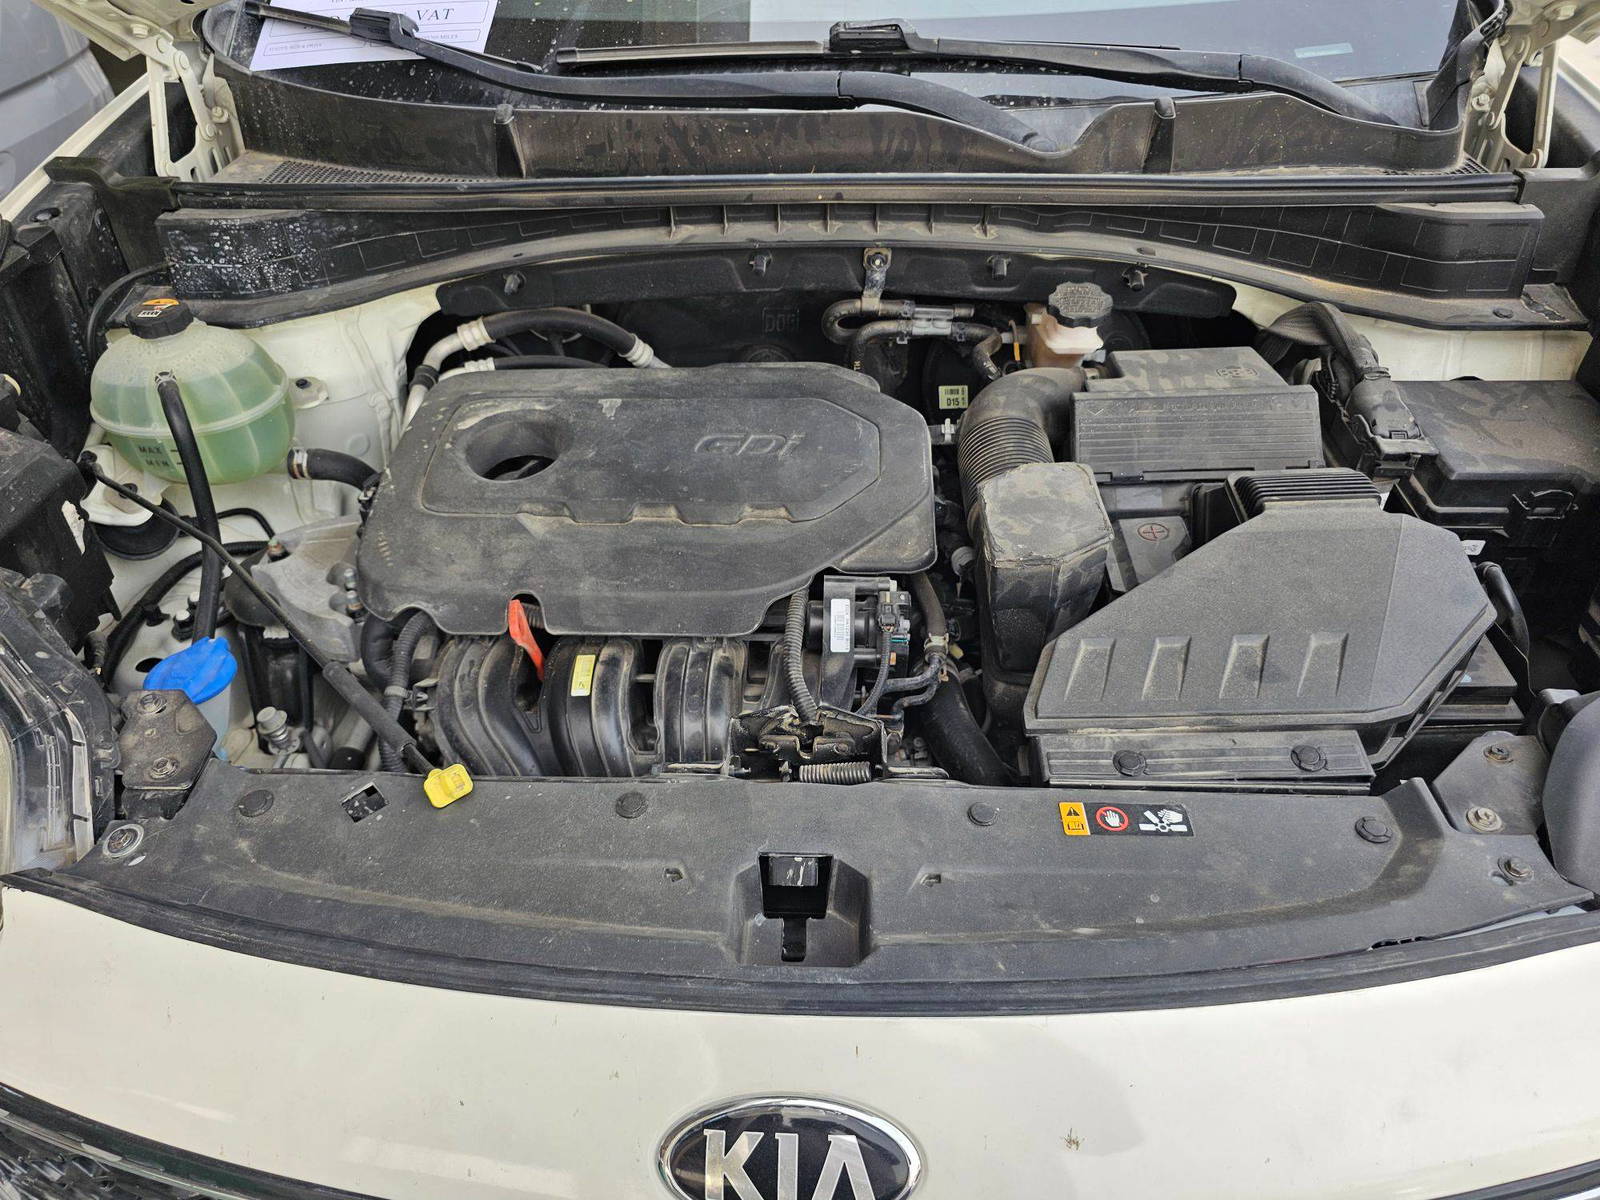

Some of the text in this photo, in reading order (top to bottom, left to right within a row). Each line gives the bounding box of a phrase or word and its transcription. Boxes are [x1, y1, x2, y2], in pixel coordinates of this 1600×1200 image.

[416, 8, 455, 21] VAT
[138, 445, 162, 454] MAX
[145, 459, 170, 467] MIN
[703, 1128, 876, 1200] KIA
